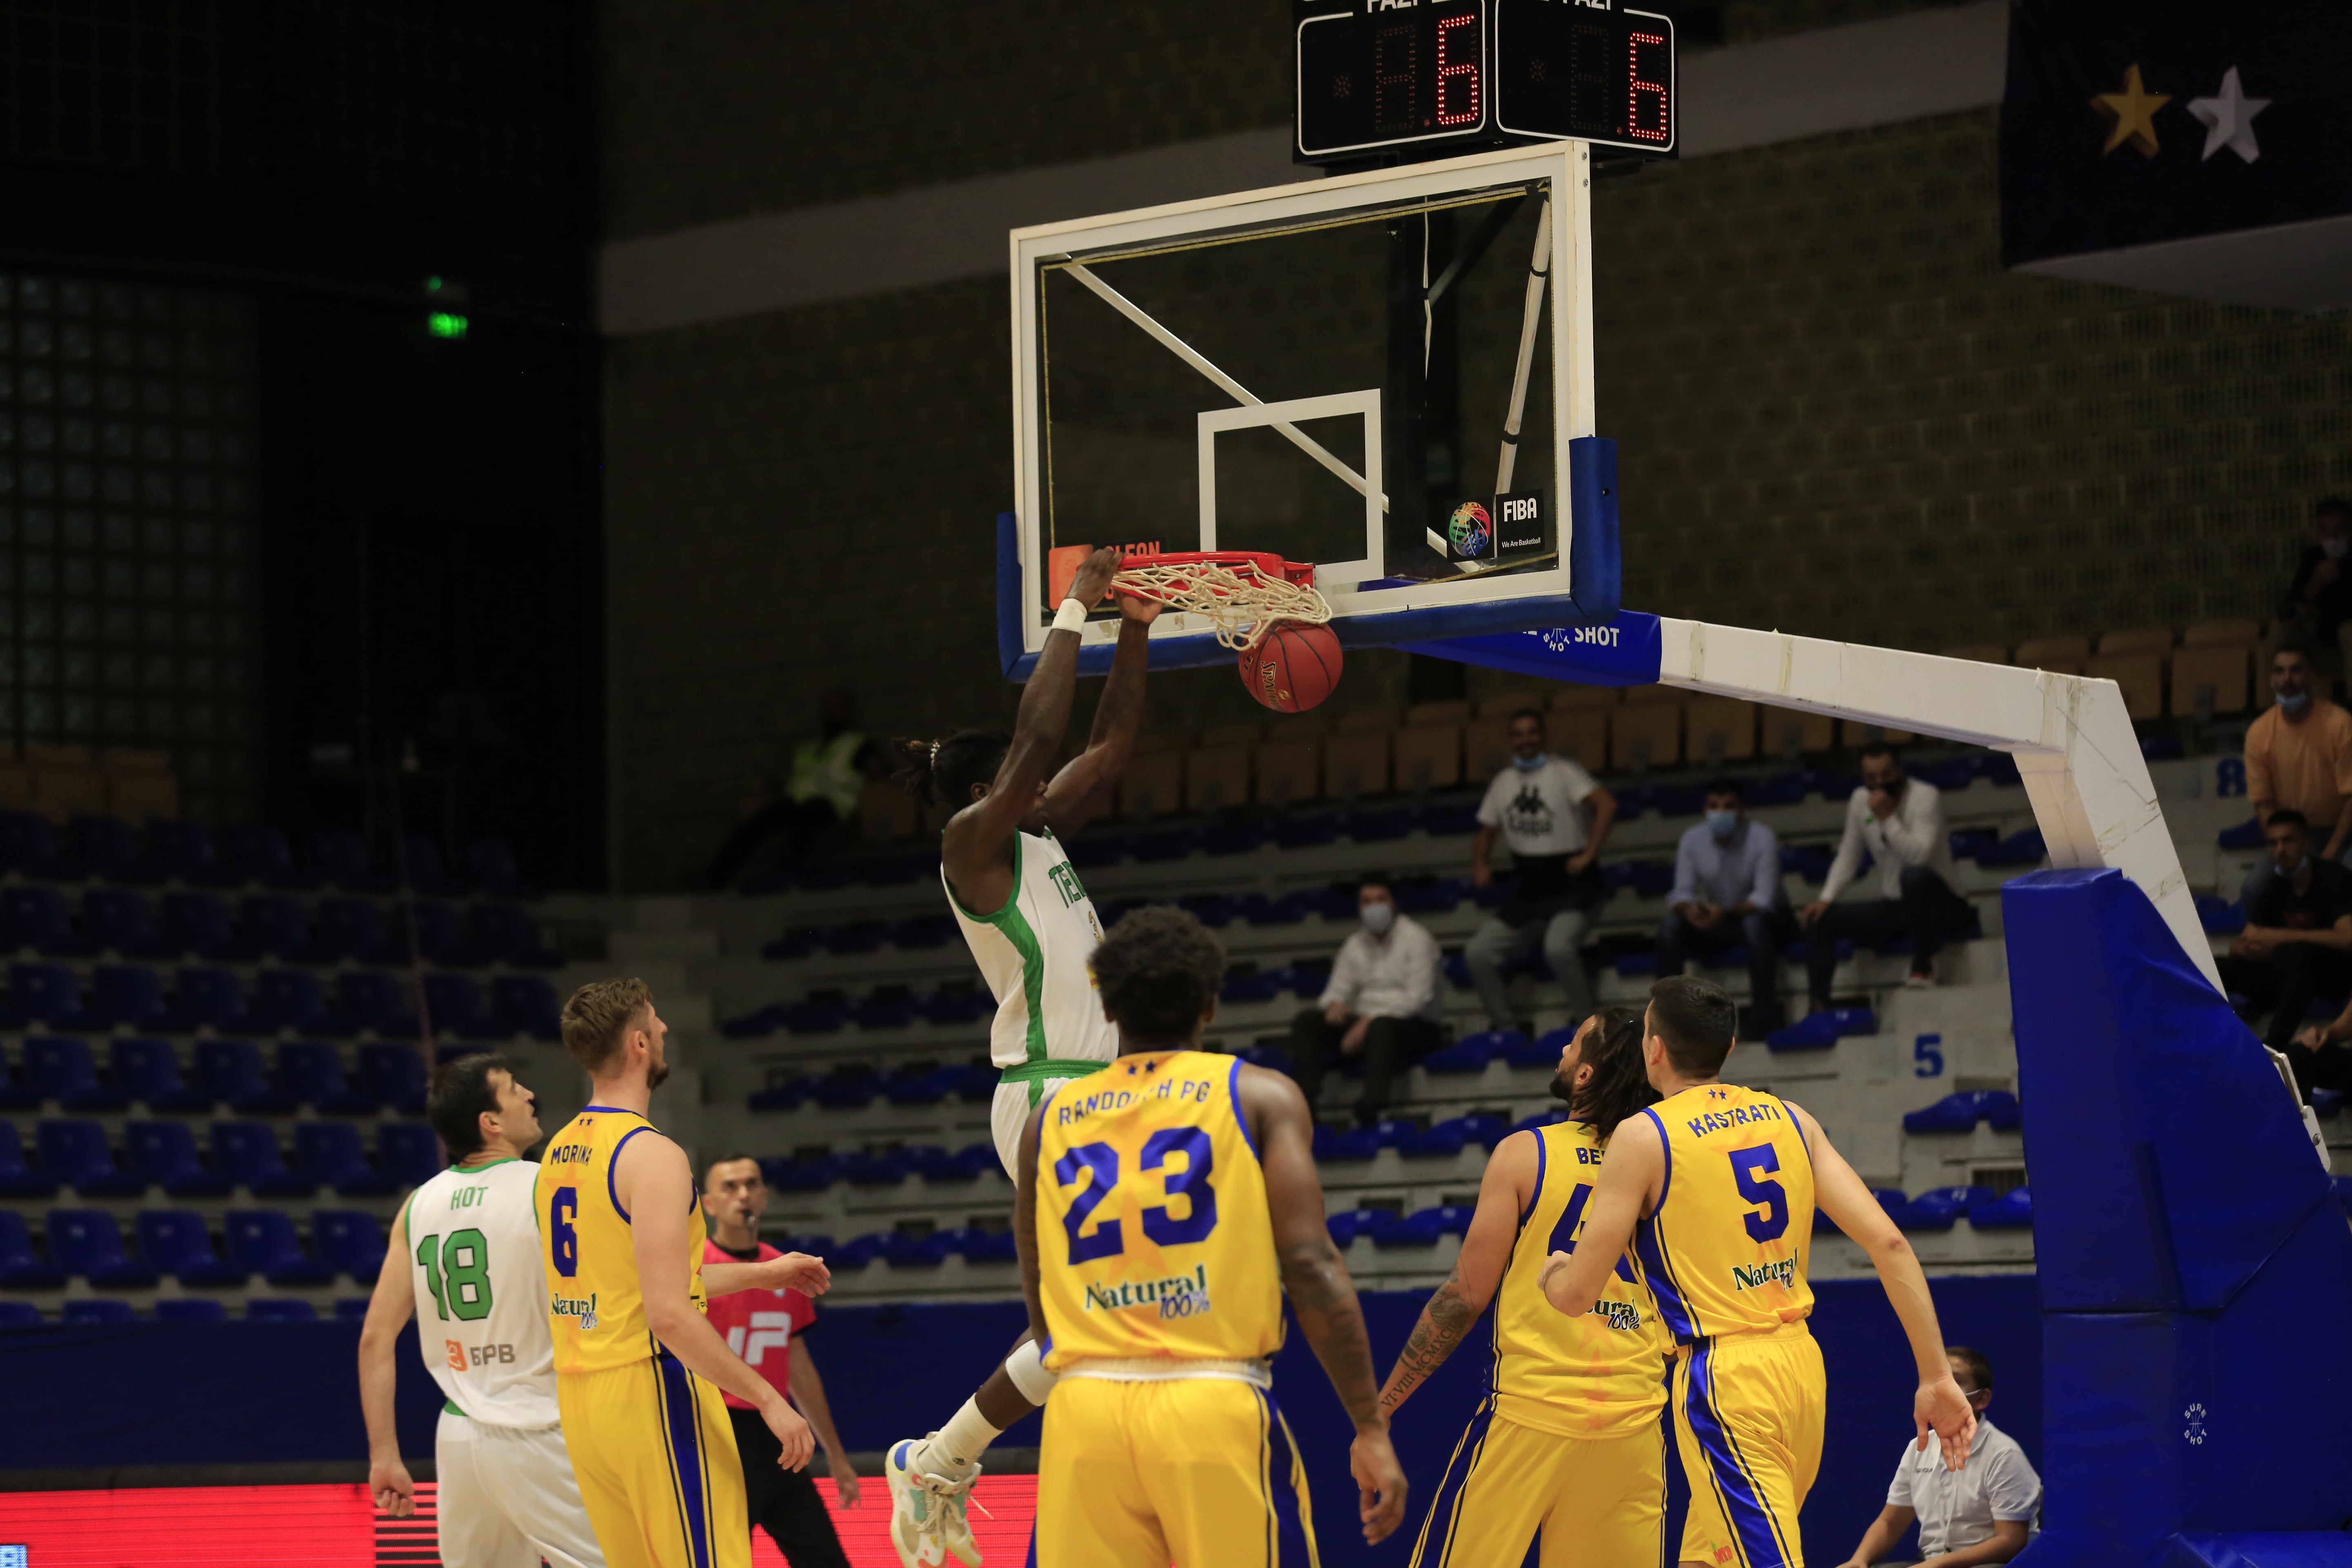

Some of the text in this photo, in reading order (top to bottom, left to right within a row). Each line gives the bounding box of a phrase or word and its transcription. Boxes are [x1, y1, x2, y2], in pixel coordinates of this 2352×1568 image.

[1438, 15, 1478, 125] 6
[1630, 32, 1666, 140] 6
[1503, 498, 1537, 522] FIBA
[1519, 537, 1541, 546] Basketball
[1575, 626, 1620, 647] SHOT
[1914, 1033, 1944, 1078] 5
[1180, 1080, 1211, 1102] PG
[1687, 1103, 1781, 1138] KASTRATI
[1575, 1147, 1606, 1165] BE
[451, 1186, 488, 1210] HOT
[1054, 1126, 1218, 1266] 23
[1728, 1142, 1789, 1244] 5
[551, 1186, 577, 1277] 6
[417, 1227, 493, 1321] 18
[1733, 1247, 1797, 1291] Natural
[1086, 1265, 1205, 1309] Natural
[1160, 1291, 1210, 1319] 100%
[1607, 1313, 1639, 1330] 100%
[2185, 1403, 2207, 1419] SURE
[2184, 1429, 2207, 1445] SHOT
